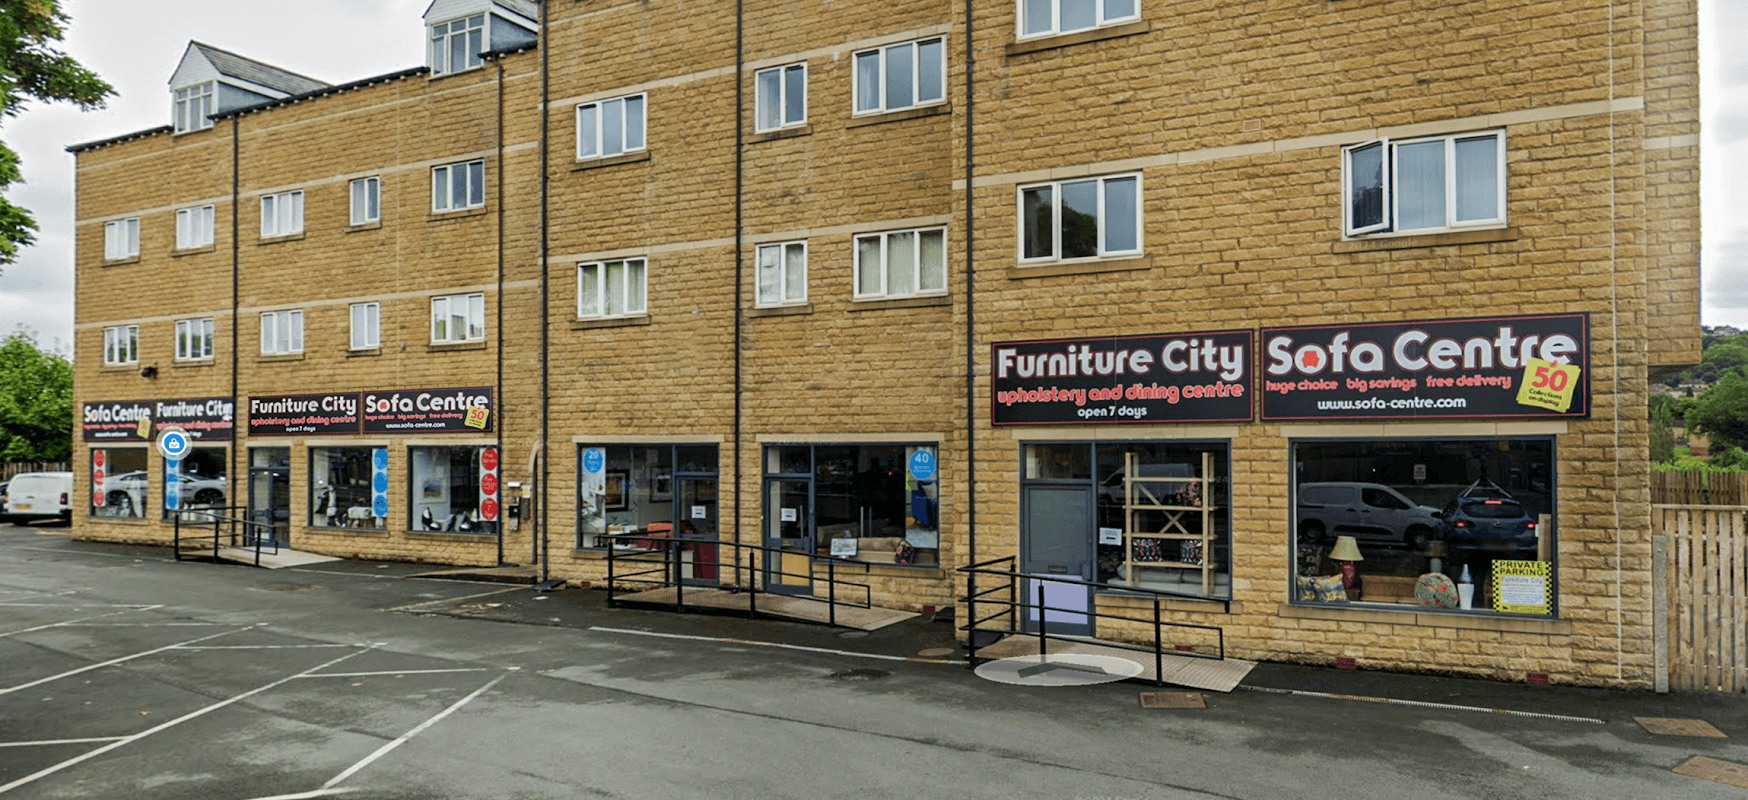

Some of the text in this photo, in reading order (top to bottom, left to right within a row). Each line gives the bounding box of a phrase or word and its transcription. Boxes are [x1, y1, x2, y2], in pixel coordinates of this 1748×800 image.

[1266, 324, 1578, 375] Sofa Centre
[997, 338, 1244, 382] Furniture City
[1265, 378, 1338, 395] huge choice
[1346, 377, 1418, 393] big savings
[1425, 373, 1512, 390] free delivery
[1532, 365, 1568, 392] 50
[365, 391, 489, 413] Sofa Centre
[997, 381, 1245, 407] upholstery and dining centre
[1528, 388, 1563, 401] Collections
[156, 400, 205, 418] Furniture
[251, 395, 357, 416] Furniture City
[1317, 396, 1467, 411] www.sofa-centre.com
[84, 403, 151, 423] Sofa Centre
[397, 413, 407, 421] big
[470, 408, 485, 421] 50
[1077, 406, 1148, 419] open 7 days
[250, 415, 357, 427] upholstery and dining centre
[914, 452, 929, 463] 40
[1499, 561, 1543, 569] PRIVATE
[1499, 568, 1544, 576] PARKING
